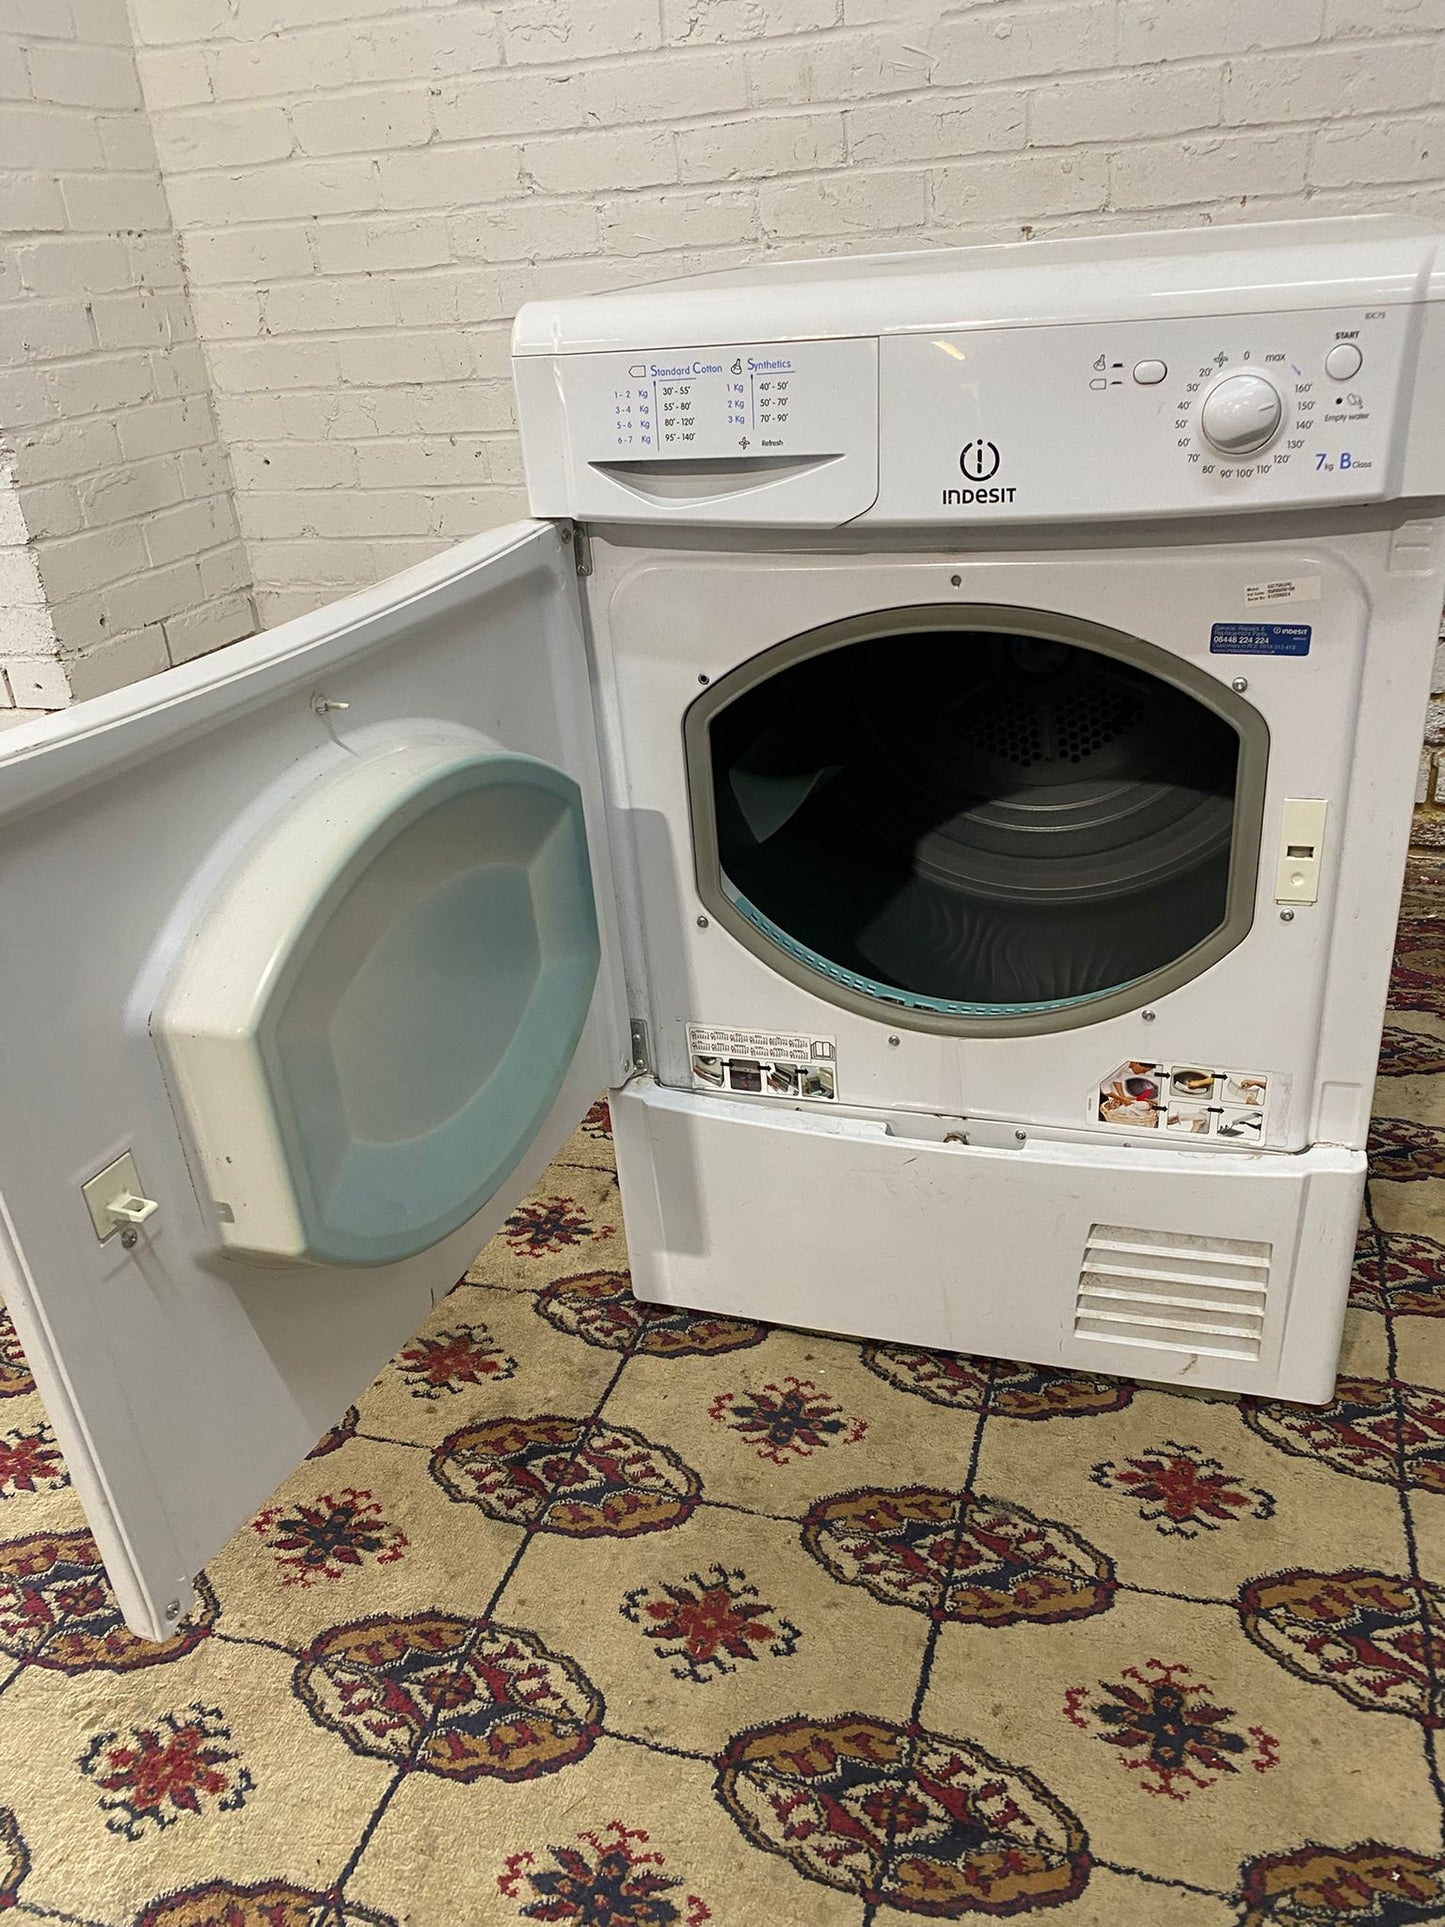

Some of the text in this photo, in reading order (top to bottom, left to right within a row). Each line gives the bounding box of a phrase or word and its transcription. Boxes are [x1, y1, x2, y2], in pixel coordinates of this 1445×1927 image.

[1335, 331, 1360, 340] START
[1244, 350, 1250, 360] 0
[1265, 352, 1286, 362] max
[650, 361, 723, 377] Standard Cotton
[747, 357, 792, 372] Synthetics
[733, 383, 744, 393] Kg
[638, 390, 648, 399] Kg
[727, 400, 745, 409] 2 Kg
[639, 405, 649, 414] Kg
[728, 415, 745, 424] 3 Kg
[1324, 413, 1370, 422] Empty water
[640, 421, 650, 430] Kg
[641, 435, 651, 445] Kg
[761, 439, 784, 447] Refresh
[1239, 636, 1253, 644] 224
